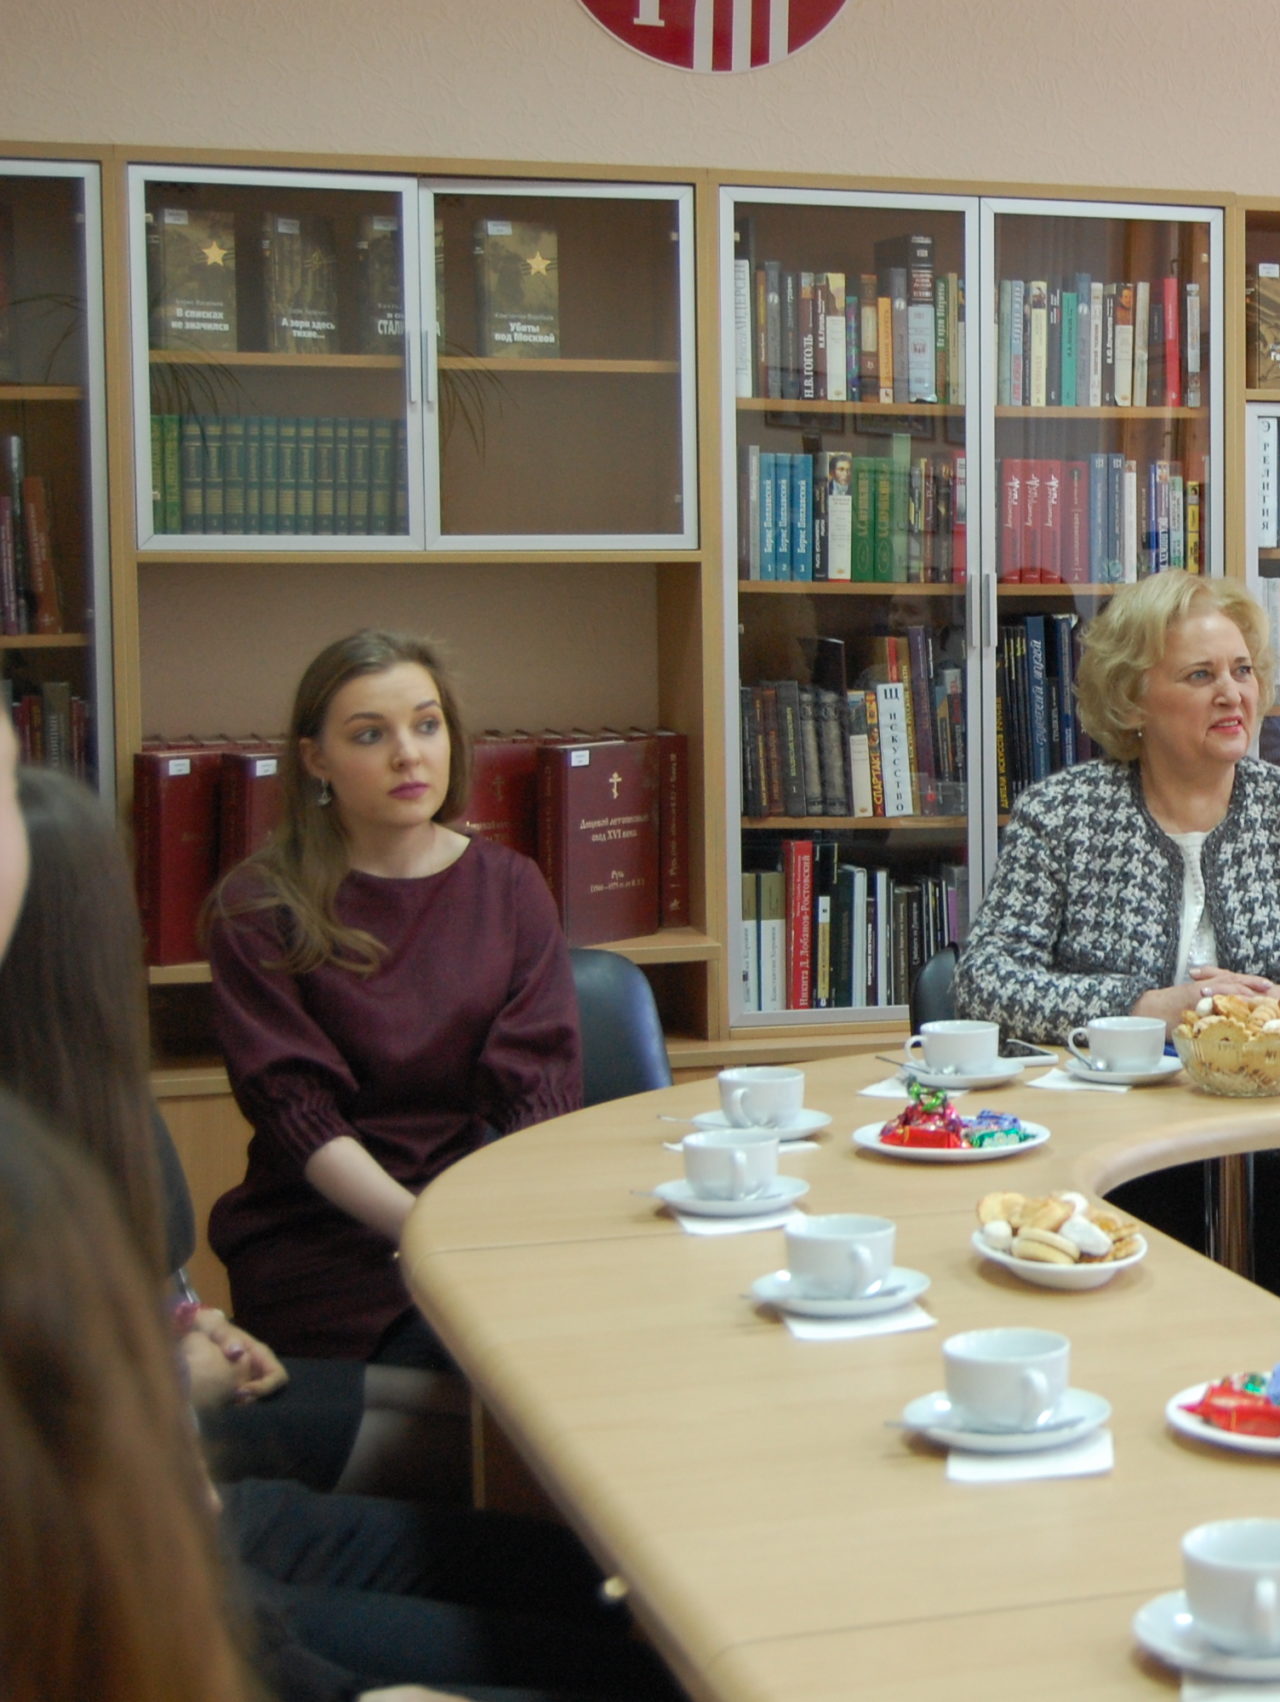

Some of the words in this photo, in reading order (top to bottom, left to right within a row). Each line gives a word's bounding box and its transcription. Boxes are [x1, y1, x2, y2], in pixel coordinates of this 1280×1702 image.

[171, 320, 182, 330] не
[184, 321, 230, 332] значился
[176, 308, 183, 318] В
[184, 309, 224, 320] списках
[494, 332, 513, 344] под
[513, 332, 556, 344] Москвой
[509, 321, 541, 333] Убиты
[803, 333, 814, 376] ГОГОЛЬ
[1261, 421, 1271, 433] Э
[1261, 442, 1271, 531] РЕЛИГИЯ
[763, 529, 775, 553] Борис
[779, 528, 790, 553] Борис
[797, 529, 808, 554] Борис
[883, 688, 900, 700] Щ
[889, 712, 905, 812] ИСКУССТВО
[800, 855, 812, 956] Лобанов-Ростовский
[800, 957, 811, 969] Д.
[800, 970, 809, 1006] Никита
